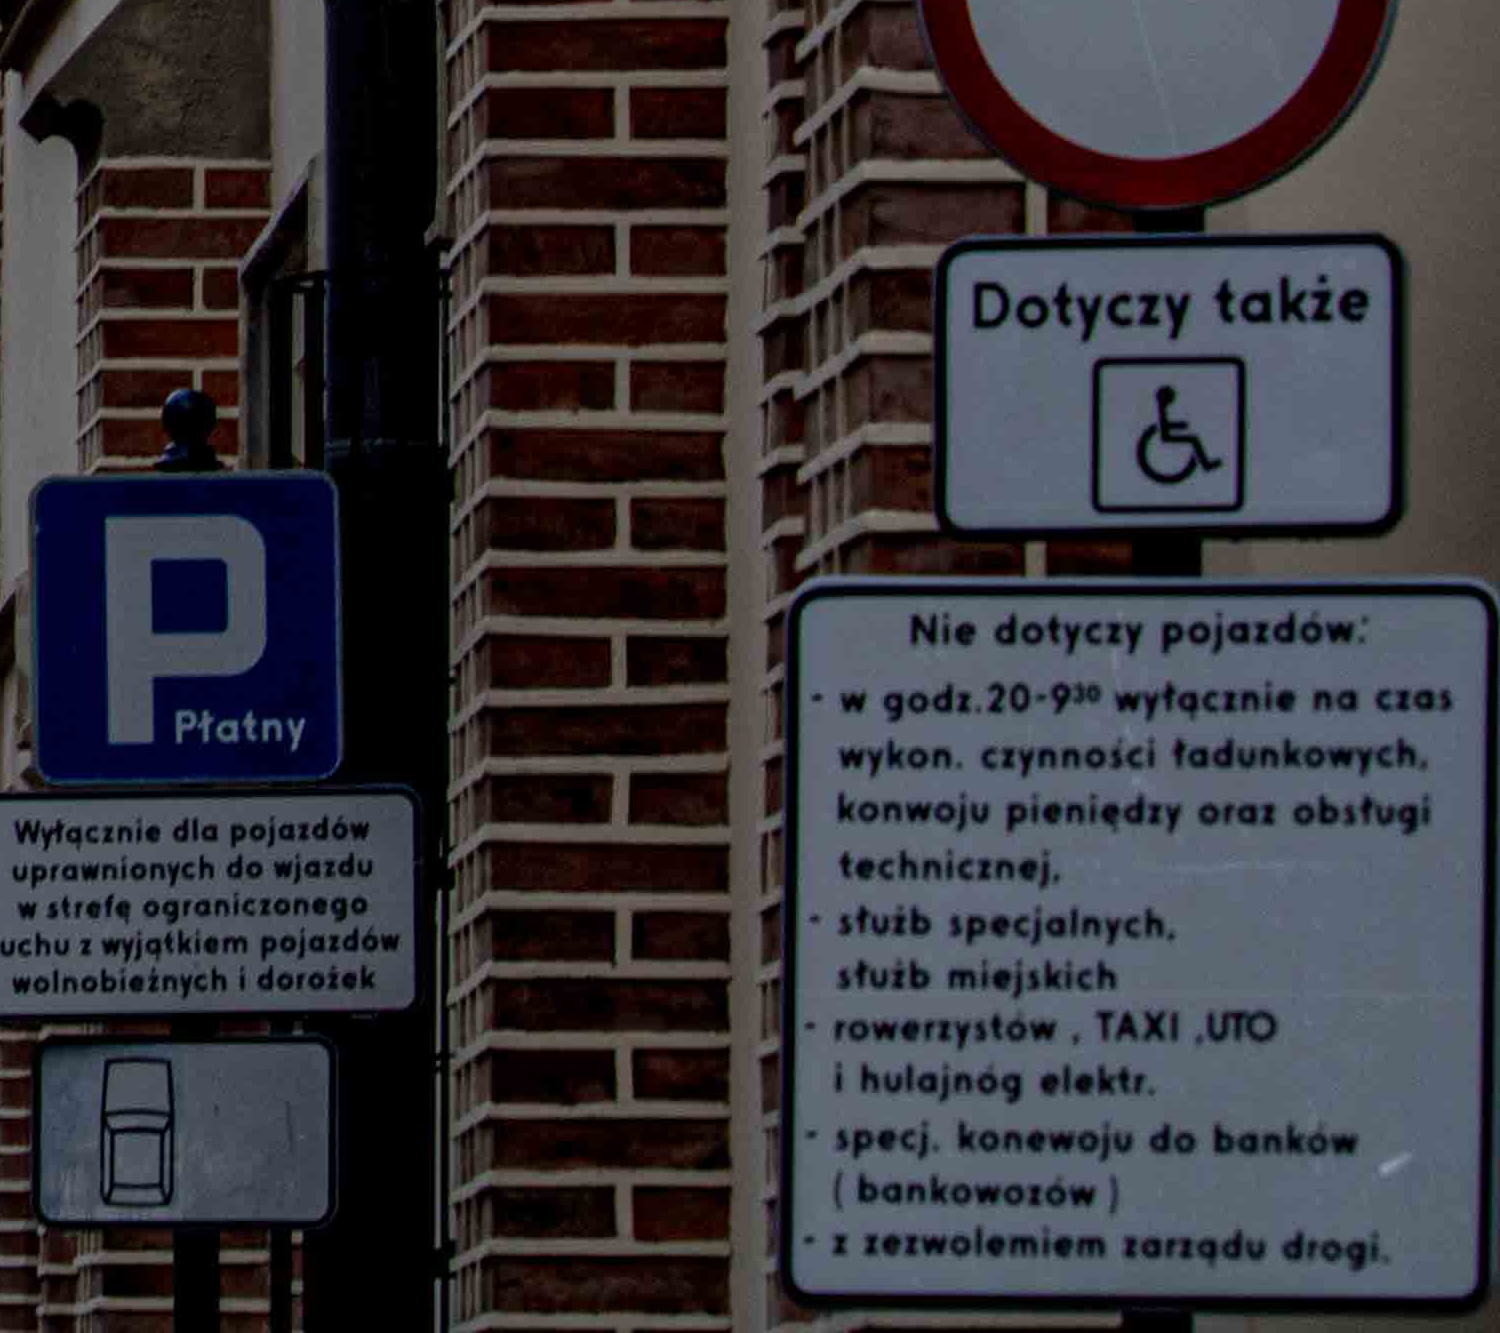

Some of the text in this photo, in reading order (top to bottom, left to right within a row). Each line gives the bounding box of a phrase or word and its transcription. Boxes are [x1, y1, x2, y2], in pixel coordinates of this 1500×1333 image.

[973, 274, 1370, 342] Dotyczy także
[910, 612, 1368, 656] Nie dotyczy pojazdów:
[840, 692, 867, 713] w
[1115, 681, 1297, 722] wyłącznie
[1312, 689, 1359, 713] na
[1374, 688, 1453, 713] czas
[175, 708, 306, 752] Płatny
[838, 739, 962, 778] wykon.
[980, 738, 1156, 779] czynności
[14, 815, 370, 849] Wyłącznie dla pojazdów
[837, 792, 1432, 836] konwoju pieniędzy oraz obsługi
[12, 849, 373, 887] uprawnionych do wjazdu
[17, 893, 368, 925] w strefę ograniczonego
[838, 905, 932, 937] służb
[79, 938, 93, 957] z
[101, 925, 248, 962] wyjątkiem
[260, 921, 401, 958] pojazdów
[12, 962, 376, 1000] wolnobieżnych i dorożek
[838, 959, 1117, 1000] służb miejskich
[834, 1013, 1057, 1051] rowerzystów
[1096, 1010, 1179, 1042] TAXI
[835, 1062, 1155, 1105] i hulajnóg elektr.
[836, 1120, 939, 1160] specj.
[1149, 1123, 1197, 1155] do
[1213, 1124, 1359, 1156] banków
[857, 1172, 1096, 1207] bankowozów
[832, 1234, 848, 1256] z
[1123, 1228, 1267, 1266] zarządu
[1281, 1231, 1389, 1273] drogi.
